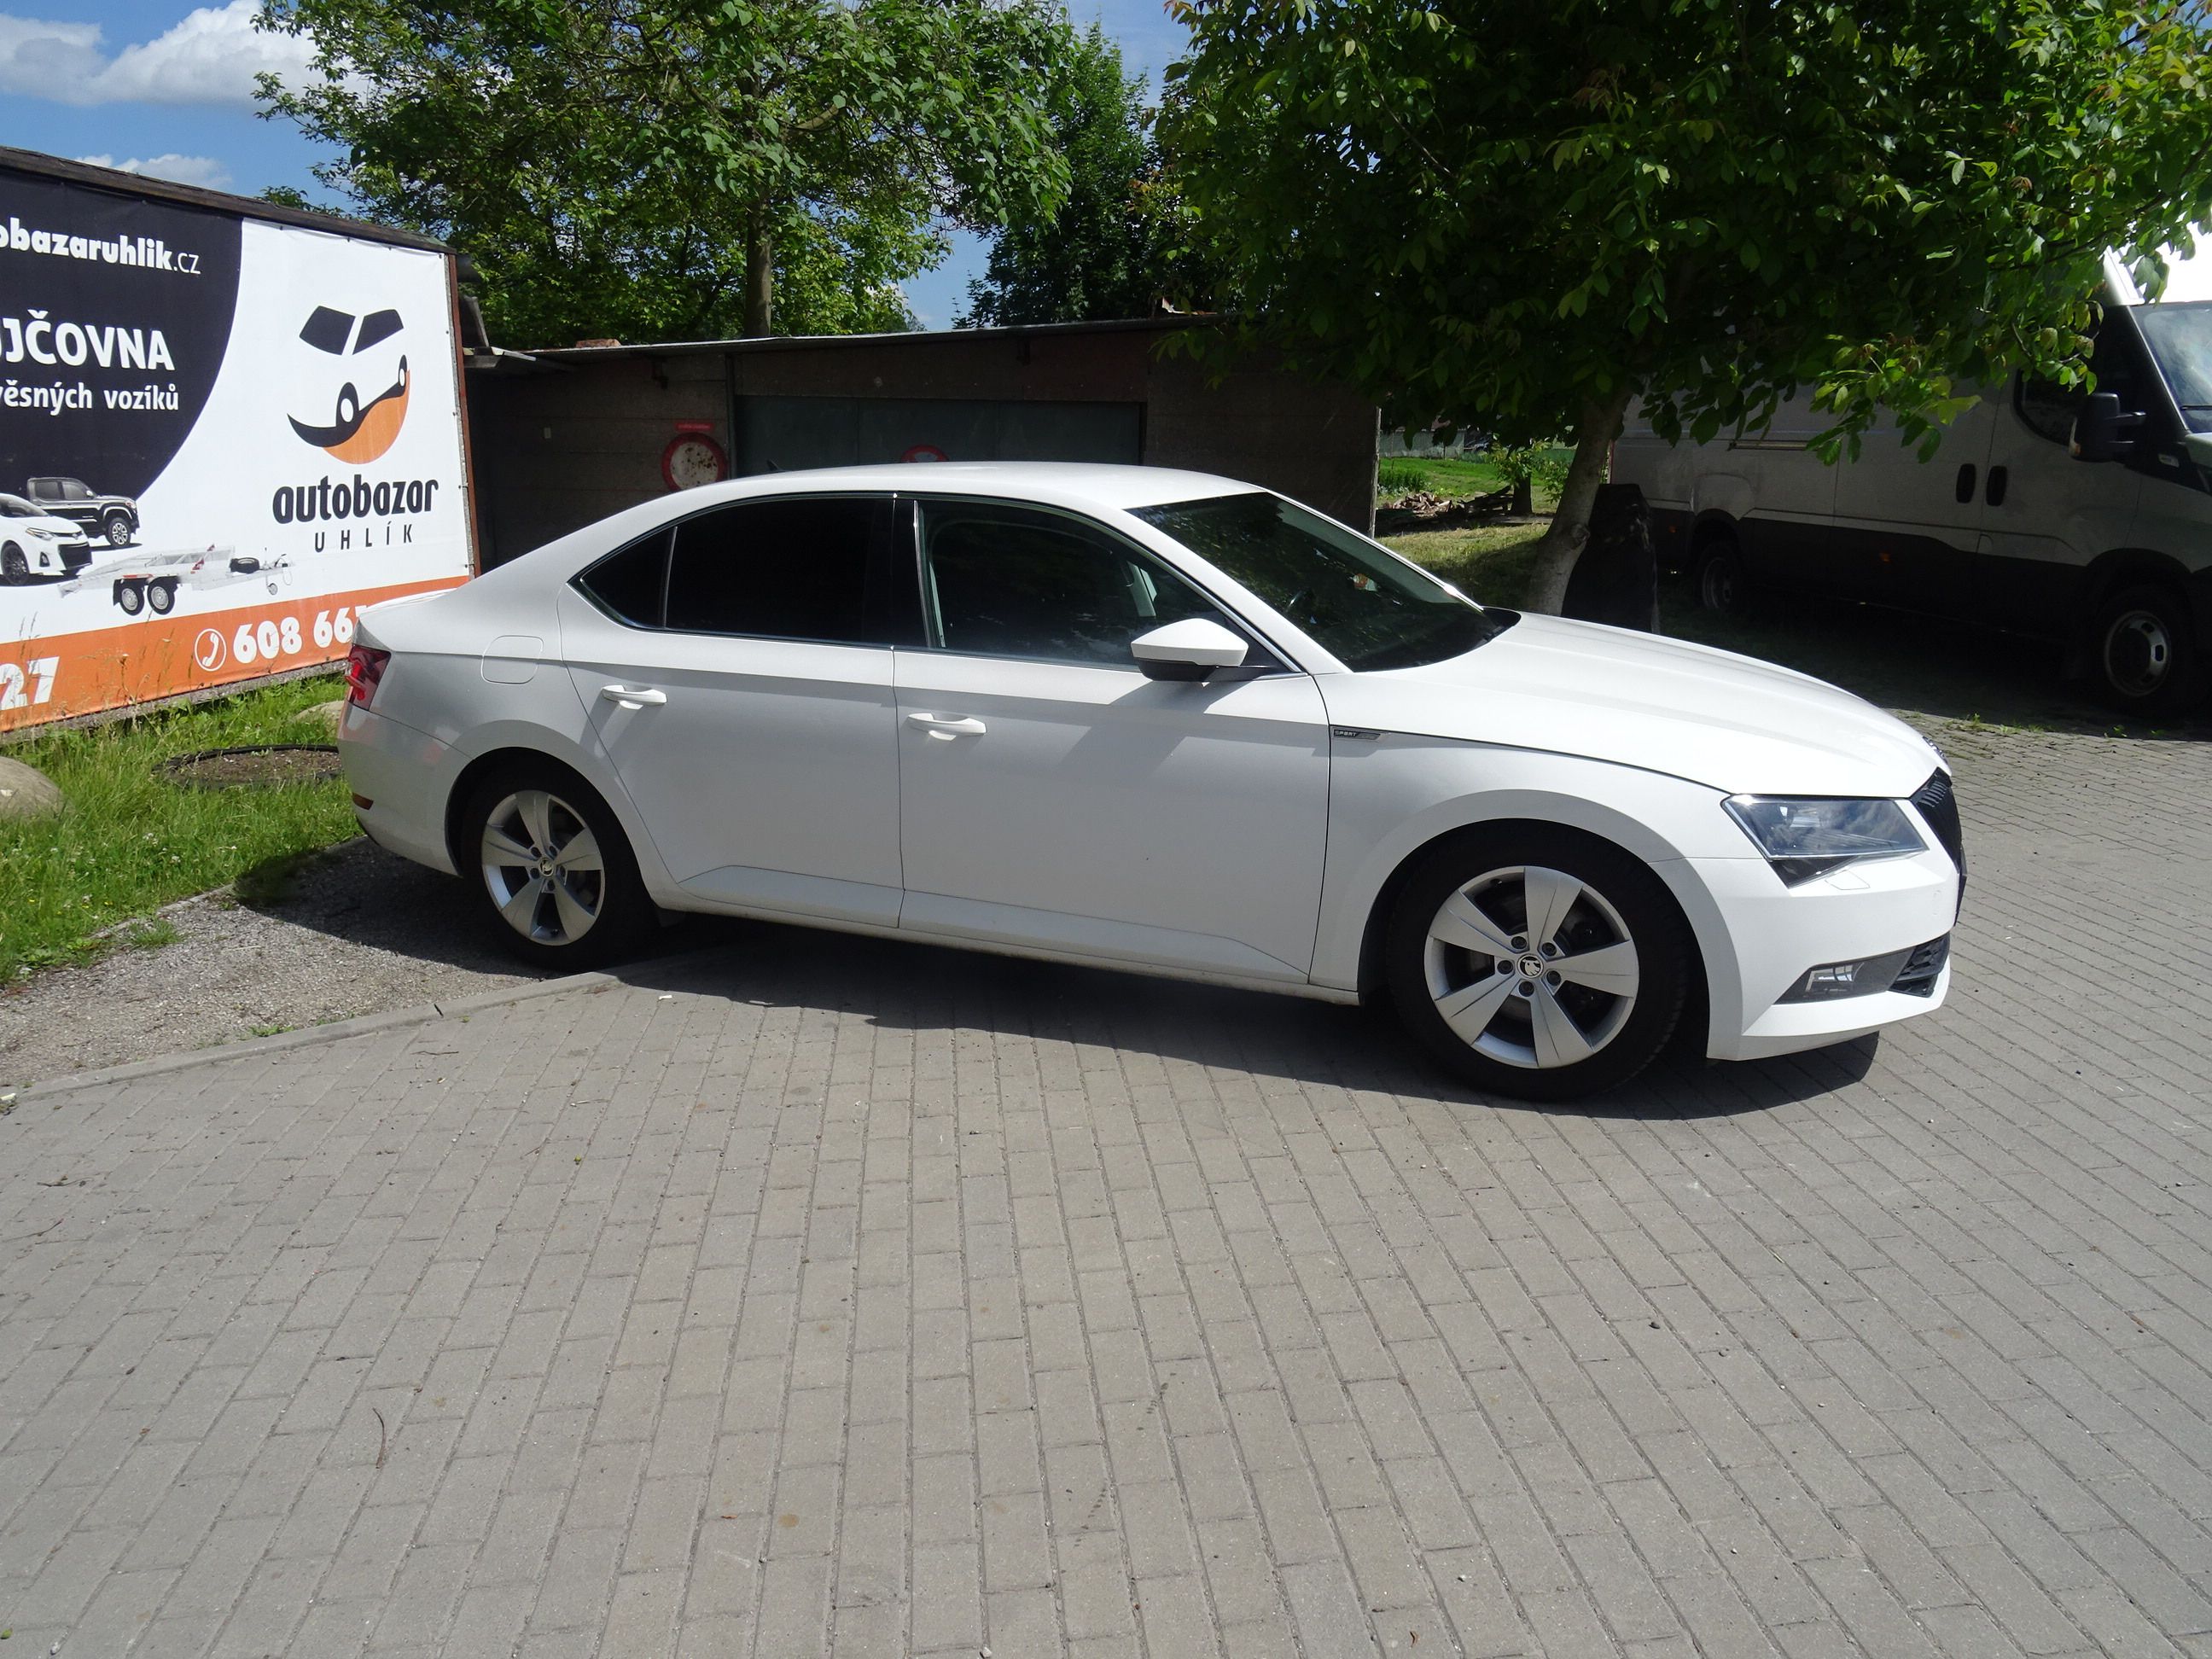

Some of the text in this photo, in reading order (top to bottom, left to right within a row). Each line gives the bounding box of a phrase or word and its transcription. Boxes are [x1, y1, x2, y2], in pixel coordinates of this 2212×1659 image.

[0, 309, 176, 370] JČOVNA
[0, 379, 179, 416] ěsných vozíků
[272, 474, 439, 525] autobazar
[314, 521, 413, 554] UHLÍK
[233, 604, 369, 665] 608 66
